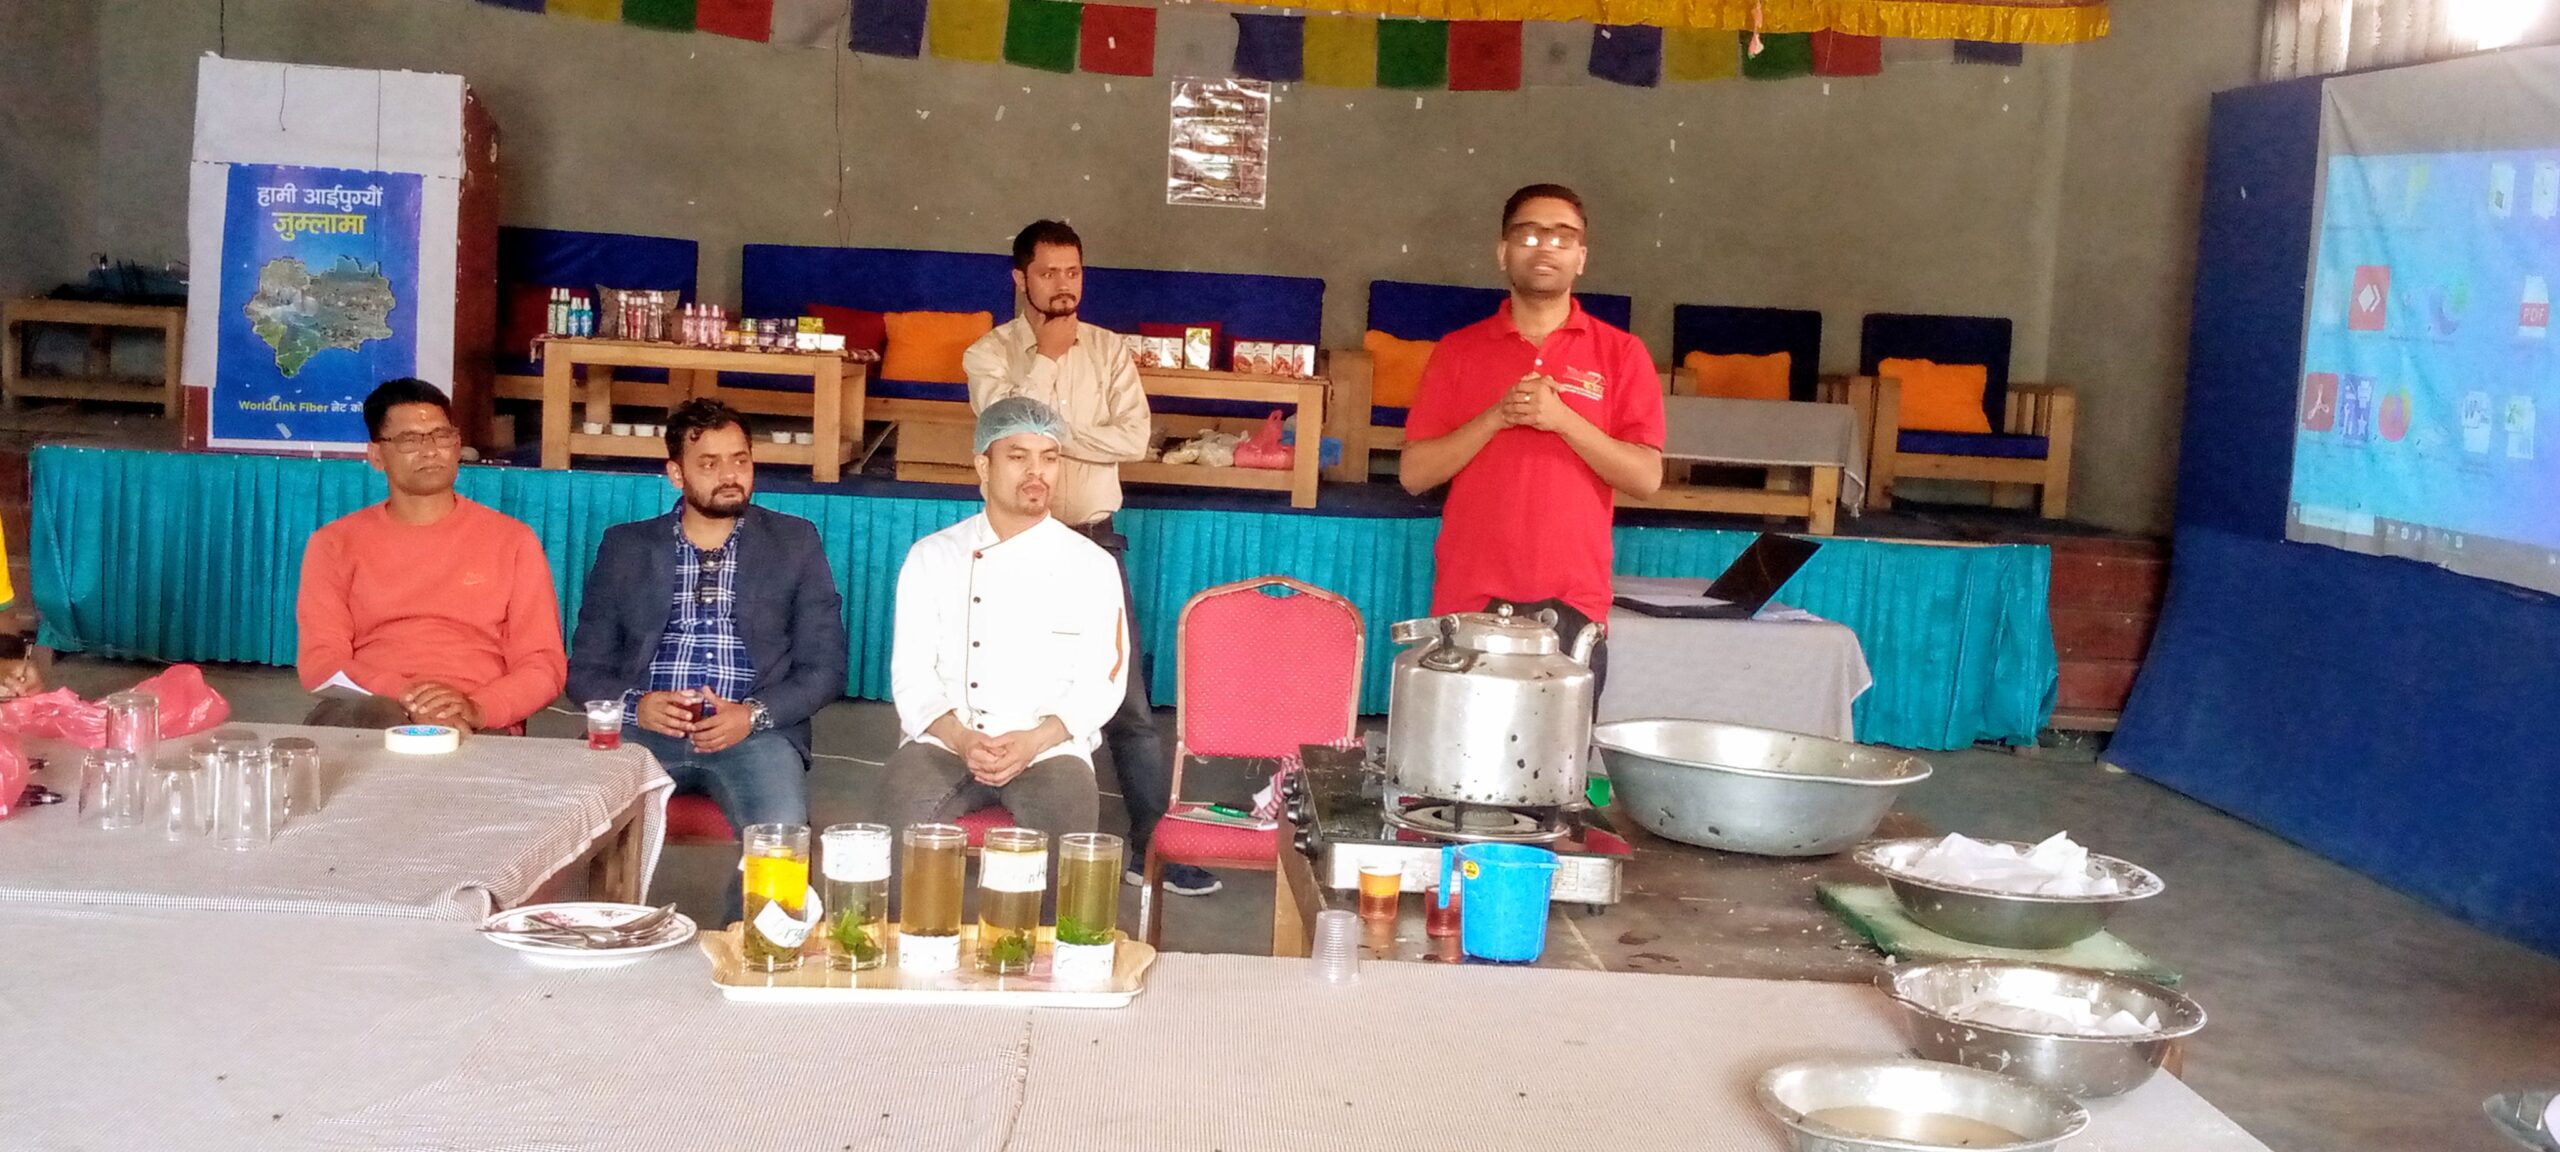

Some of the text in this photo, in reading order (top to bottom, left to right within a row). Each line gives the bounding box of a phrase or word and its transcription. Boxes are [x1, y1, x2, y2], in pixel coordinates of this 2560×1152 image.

[257, 183, 298, 207] हामी
[271, 212, 367, 242] जुम्लामा
[238, 400, 296, 411] WorldLink
[299, 402, 329, 413] Fiber
